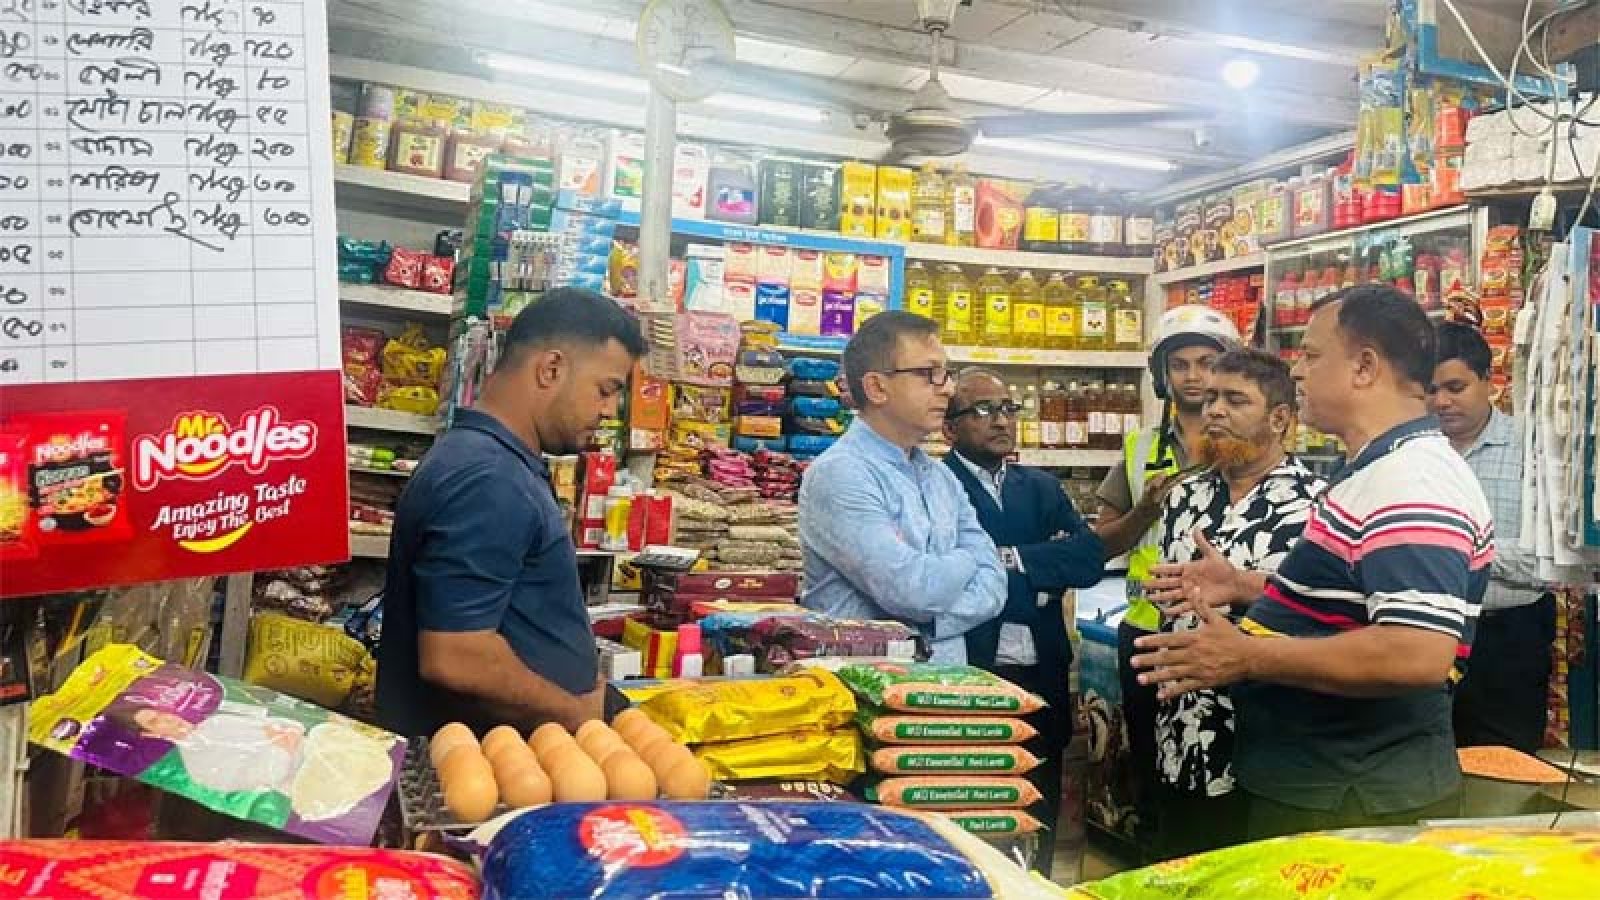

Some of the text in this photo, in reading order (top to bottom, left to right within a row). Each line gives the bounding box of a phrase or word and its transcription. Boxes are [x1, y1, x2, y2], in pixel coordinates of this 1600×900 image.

[138, 408, 309, 481] Noodles
[254, 474, 307, 502] Taste
[150, 492, 249, 530] Amazing
[255, 499, 291, 523] Best
[173, 518, 217, 540] Enjoy
